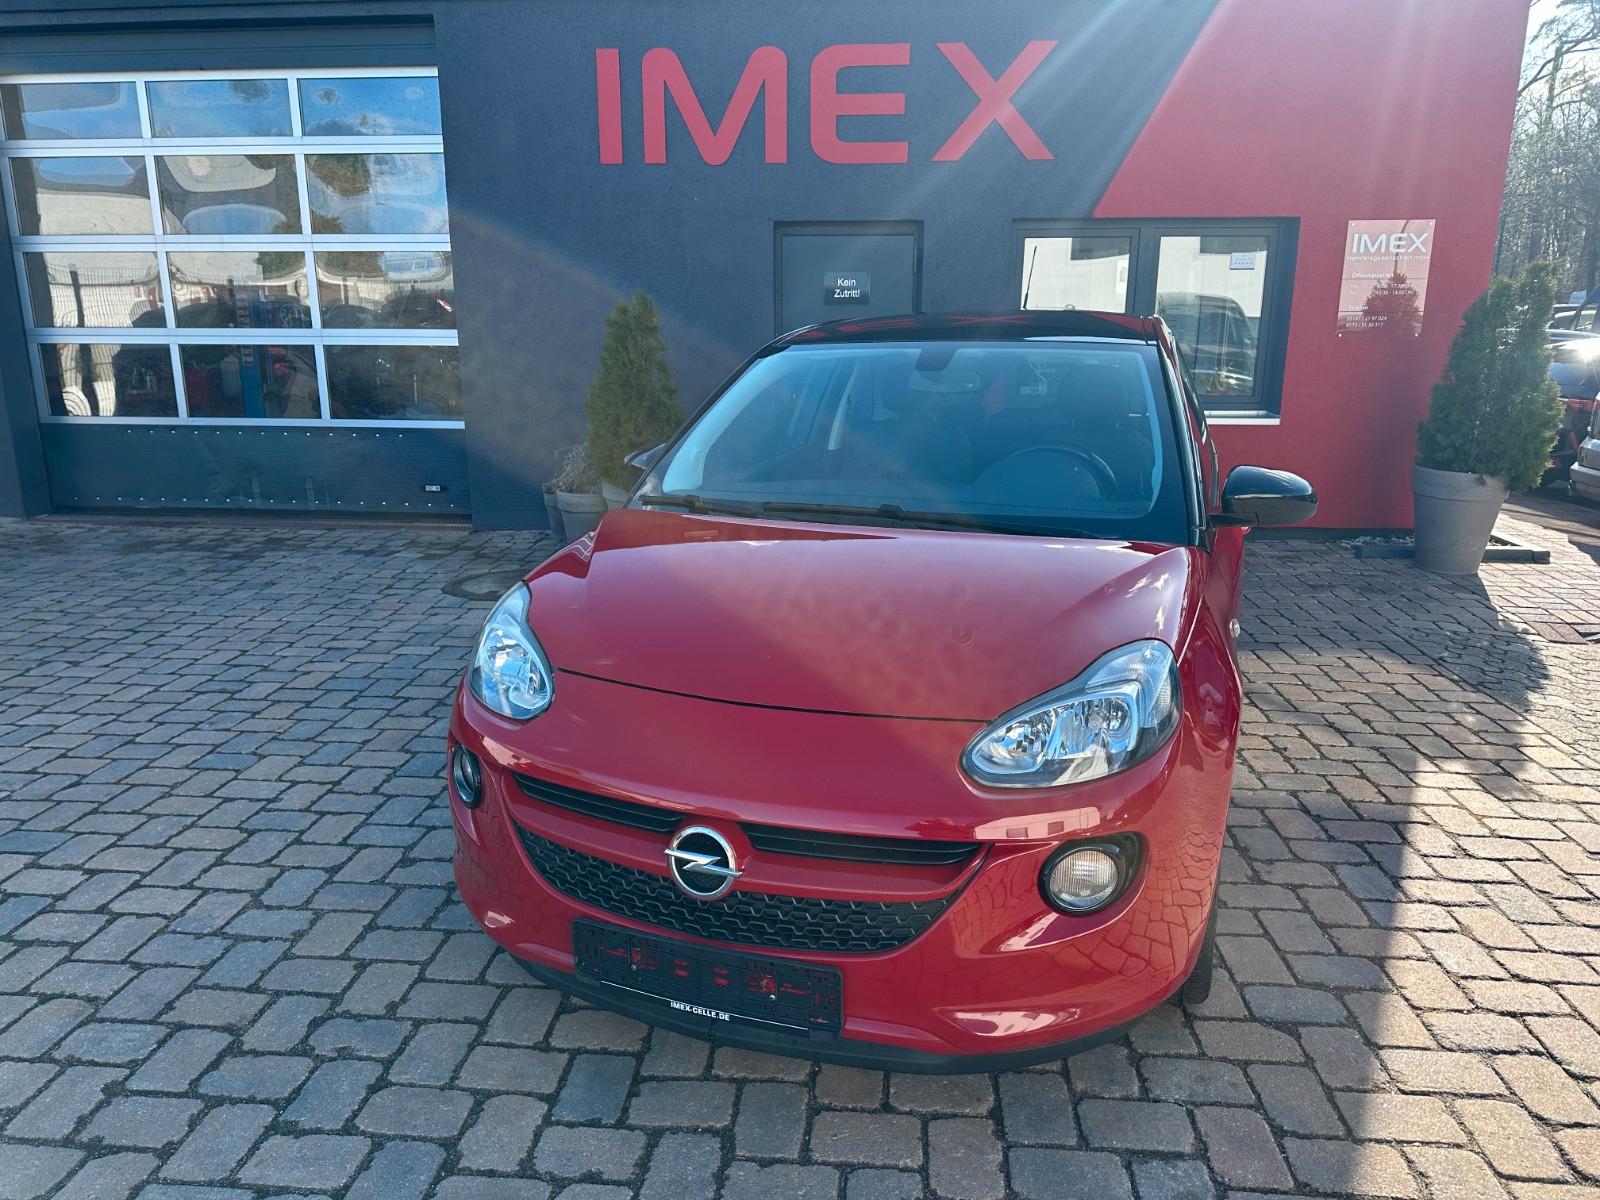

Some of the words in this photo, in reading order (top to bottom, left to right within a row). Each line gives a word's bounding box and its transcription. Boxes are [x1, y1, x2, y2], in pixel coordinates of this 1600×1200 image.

[595, 40, 1059, 165] IMEX
[1351, 232, 1429, 253] IMEX
[837, 277, 856, 287] Kein
[834, 289, 861, 298] Zutritt!
[670, 1001, 730, 1021] IMEX-CELLE.DE
